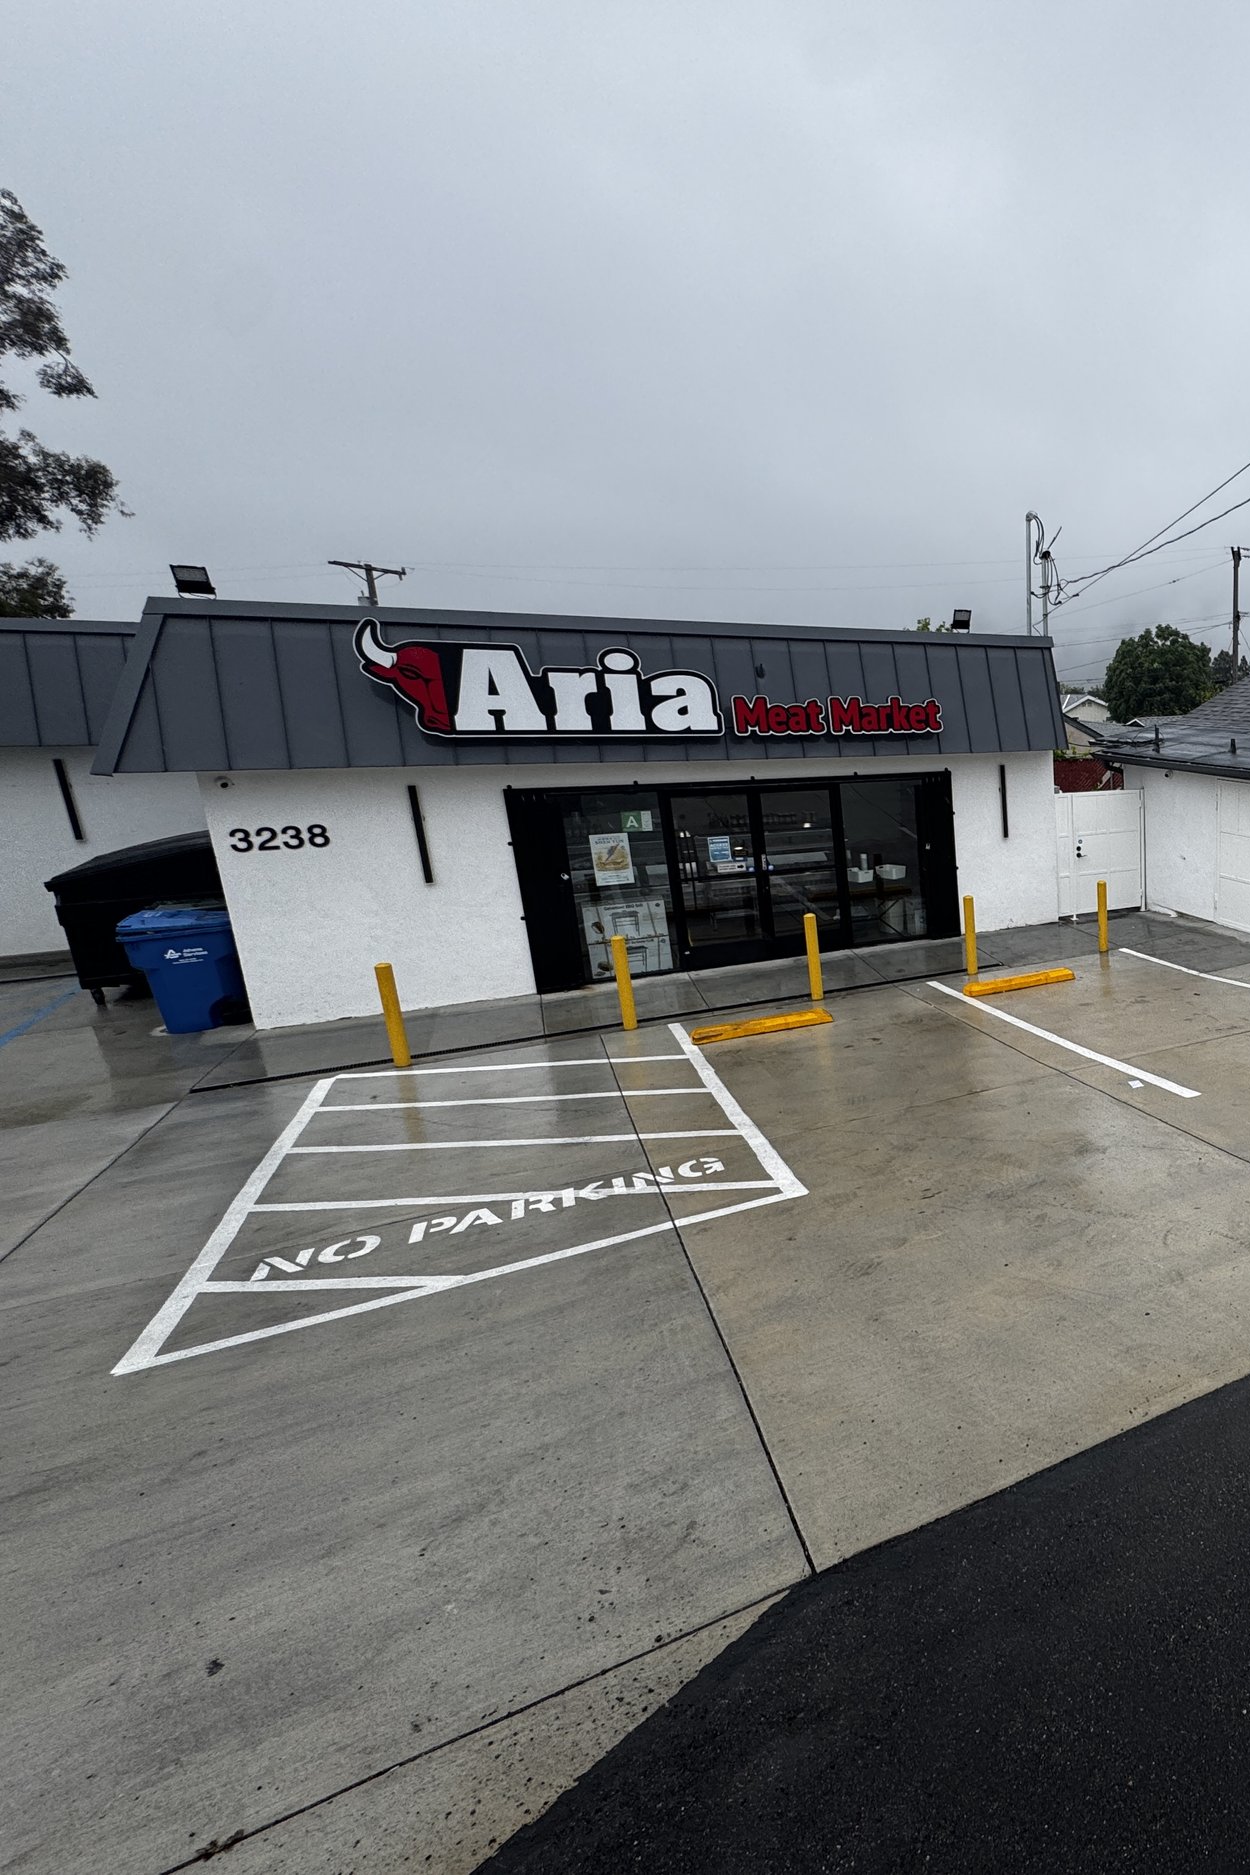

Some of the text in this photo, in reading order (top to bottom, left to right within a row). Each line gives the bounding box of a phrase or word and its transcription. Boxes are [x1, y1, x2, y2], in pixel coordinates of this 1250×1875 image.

[454, 649, 719, 732] Aria
[735, 697, 940, 732] Meat Market
[229, 824, 330, 852] 3238
[626, 816, 639, 828] A
[250, 1157, 725, 1281] NO PARKING
